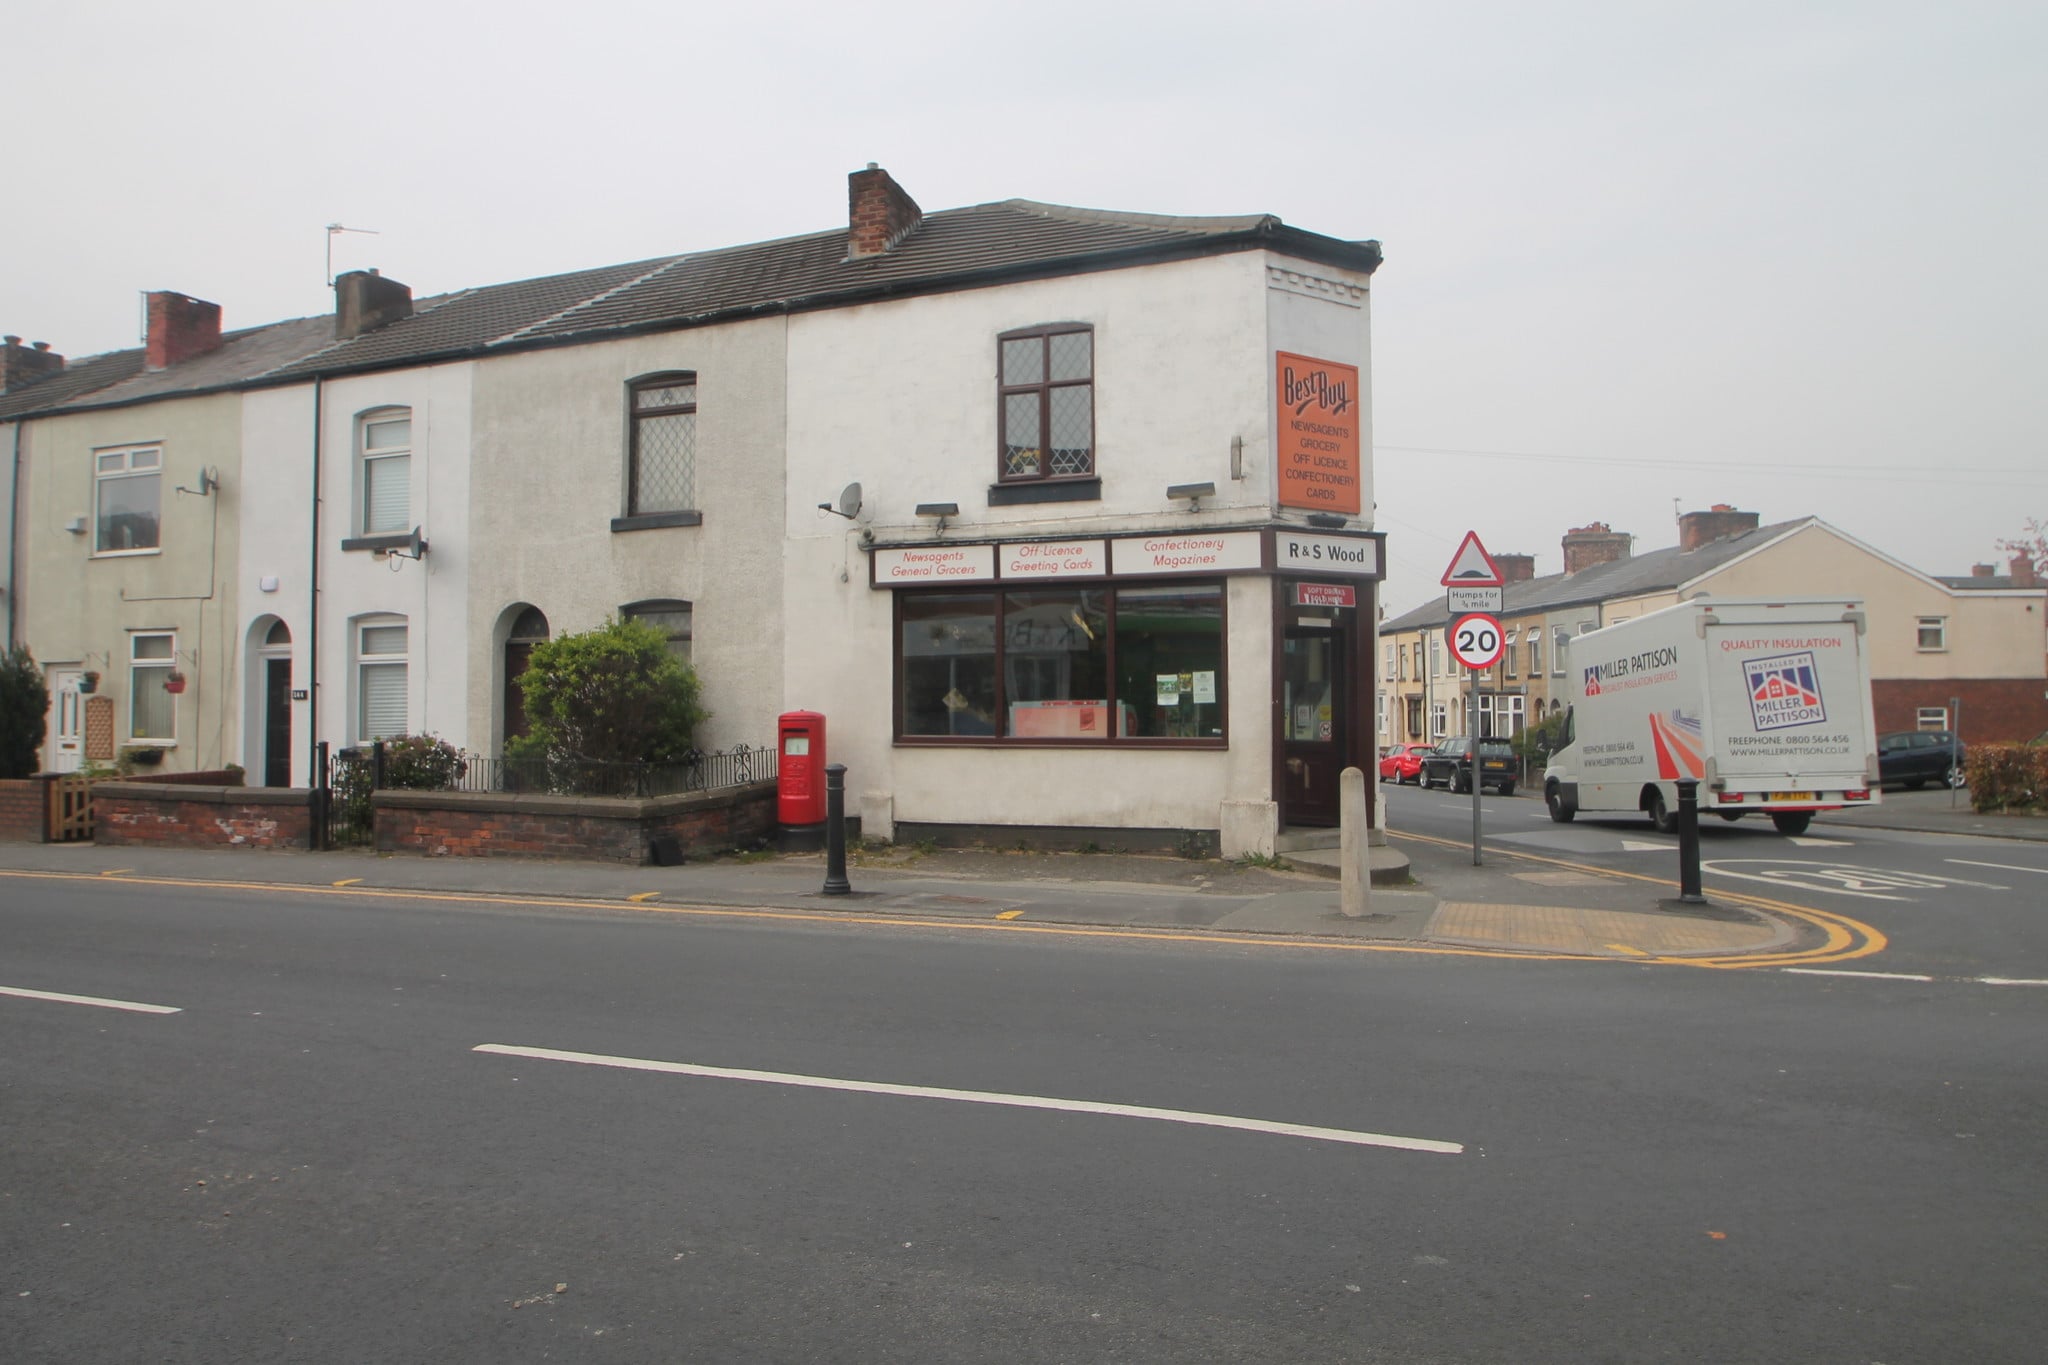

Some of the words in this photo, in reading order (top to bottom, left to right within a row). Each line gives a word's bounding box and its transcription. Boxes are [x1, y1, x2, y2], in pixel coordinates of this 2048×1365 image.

[1284, 367, 1317, 406] Best
[1317, 371, 1352, 415] Buy
[1291, 420, 1349, 438] NEWSAGENTS
[1300, 438, 1341, 453] GROCERY
[1293, 454, 1310, 464] OFF
[1314, 456, 1348, 470] LICENCE
[1286, 468, 1354, 486] CONFECTIONERY
[1306, 487, 1336, 500] CARDS
[1019, 546, 1083, 558] Off-Licence
[1144, 538, 1224, 552] Confectionery
[903, 551, 964, 564] Newsagents
[1289, 543, 1299, 558] R
[1302, 545, 1310, 556] &
[1313, 544, 1322, 559] S
[1328, 546, 1365, 562] Wood
[1011, 560, 1058, 573] Greeting
[1064, 559, 1092, 570] Cards
[1153, 554, 1216, 568] Magazines
[892, 566, 932, 577] General
[937, 565, 976, 575] Grocers
[1307, 586, 1323, 594] SOFT
[1452, 591, 1483, 599] Humps
[1485, 591, 1498, 599] for
[1458, 630, 1496, 652] 20
[1721, 639, 1769, 651] QUALITY
[1772, 638, 1841, 649] INSULATION
[1600, 658, 1629, 680] MILLER
[1631, 645, 1677, 673] PATTISON
[1748, 659, 1794, 671] INSTALLED
[1798, 657, 1808, 665] BY
[1624, 676, 1653, 688] INSULATION
[1654, 671, 1678, 683] SERVICES
[1756, 698, 1801, 713] MILLER
[1758, 707, 1820, 725] PATTISON
[1728, 736, 1782, 745] FREEPHONE
[1786, 735, 1810, 744] 0800
[1812, 735, 1830, 744] 564
[1832, 734, 1849, 743] 456
[1730, 747, 1849, 757] WWW.MILLERPATTISON.CO.UK
